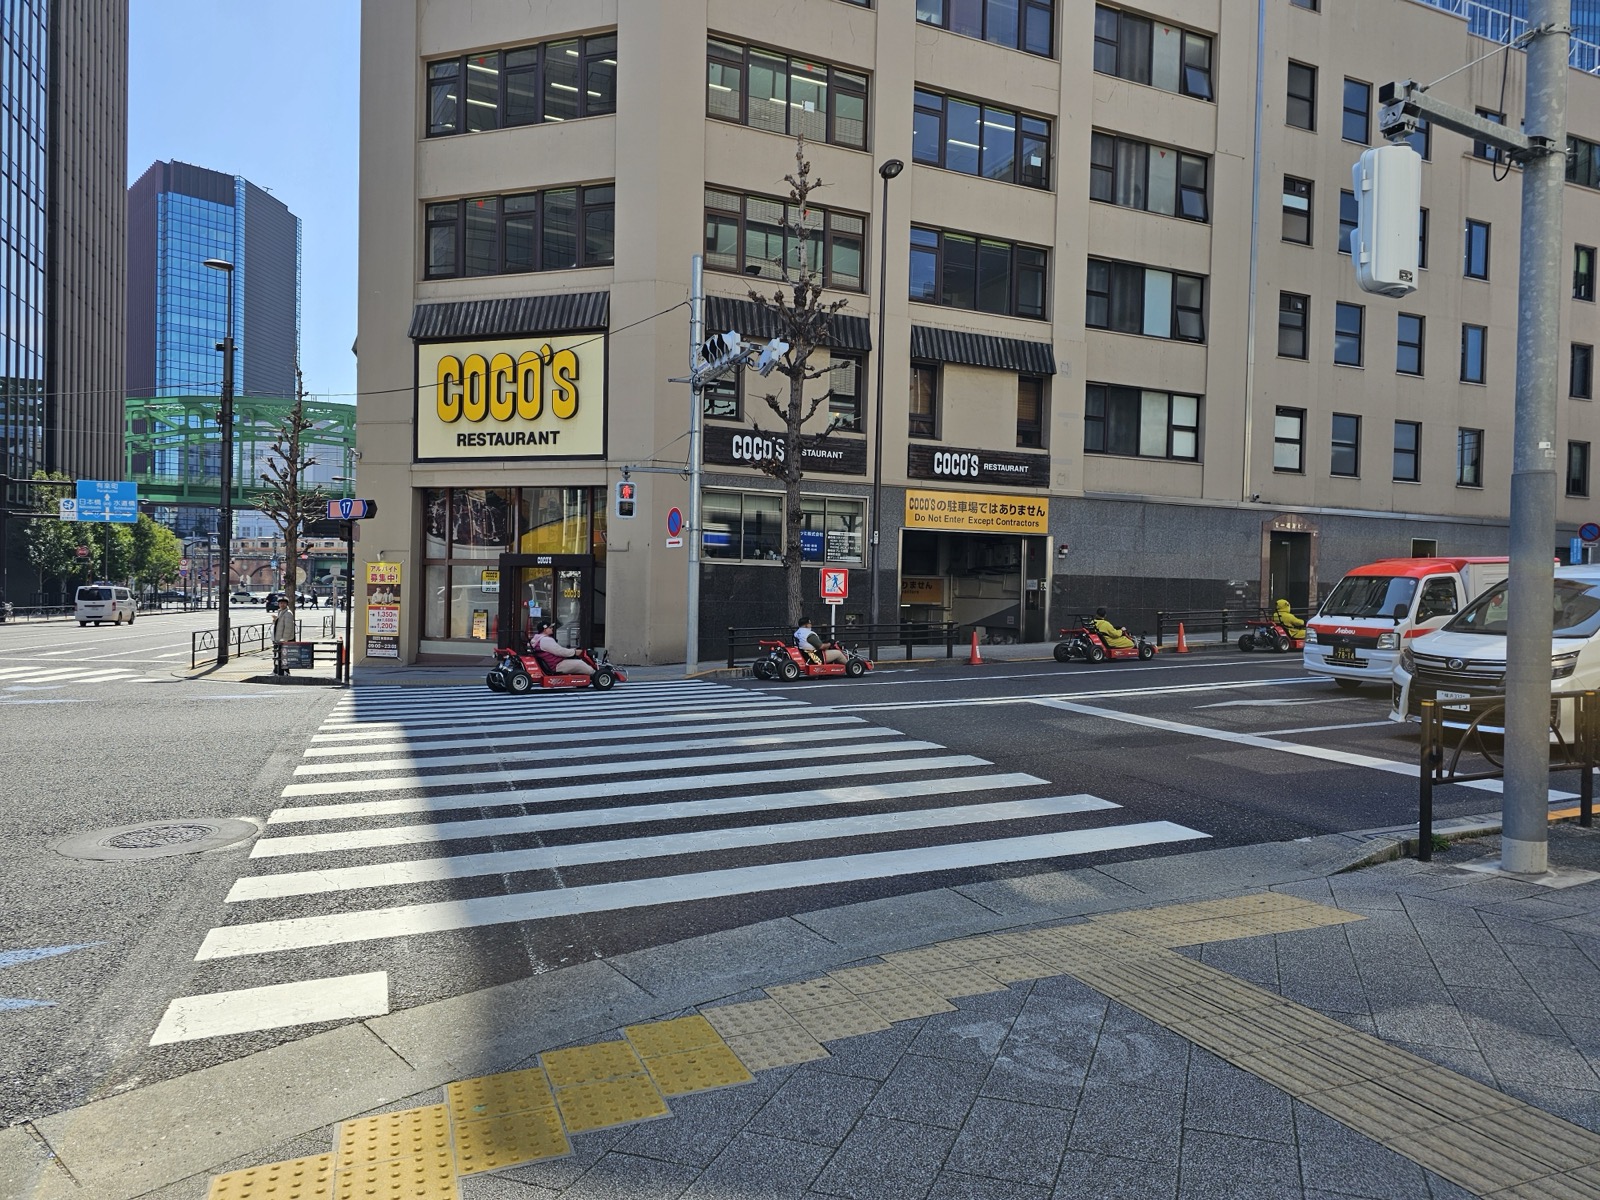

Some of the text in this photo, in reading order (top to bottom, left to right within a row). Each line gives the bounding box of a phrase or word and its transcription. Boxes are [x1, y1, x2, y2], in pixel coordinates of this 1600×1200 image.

[437, 343, 579, 423] COCO'S
[456, 430, 560, 446] RESTAURANT
[732, 434, 785, 462] COCO'S
[934, 451, 1029, 477] COCO'S RESTAURANT
[342, 501, 351, 514] 17
[914, 513, 1040, 527] Do Not Enter Except Contractors
[537, 556, 552, 564] COCO'S
